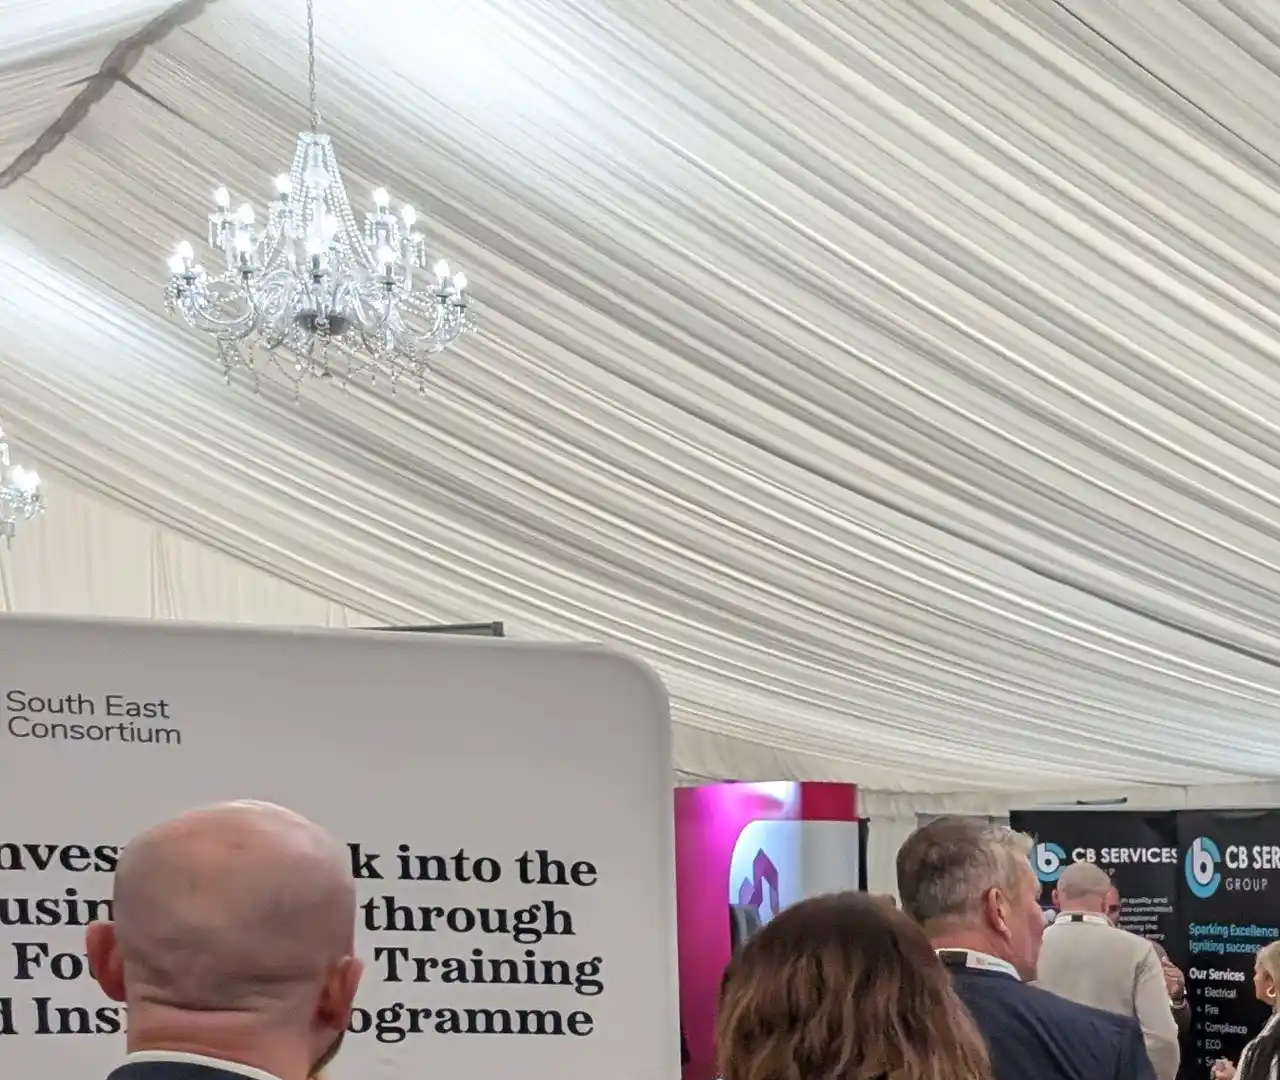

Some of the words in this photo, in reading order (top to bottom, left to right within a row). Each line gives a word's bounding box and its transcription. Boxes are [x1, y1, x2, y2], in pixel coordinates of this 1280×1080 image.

[6, 690, 95, 716] South
[105, 694, 170, 719] East
[8, 716, 181, 745] Consortium
[0, 842, 126, 872] nves
[397, 844, 501, 883] into
[515, 850, 598, 887] the
[1072, 848, 1096, 863] CB
[1101, 847, 1178, 863] SERVICES
[1225, 845, 1248, 869] CB
[1225, 878, 1268, 891] GROUP
[0, 888, 114, 926] usin
[360, 896, 576, 944] through
[1188, 923, 1229, 938] Sparking
[1230, 924, 1280, 938] Excellence
[374, 947, 604, 996] Training
[1189, 968, 1206, 980] Our
[1208, 968, 1245, 982] Services
[346, 1002, 594, 1043] ogramme
